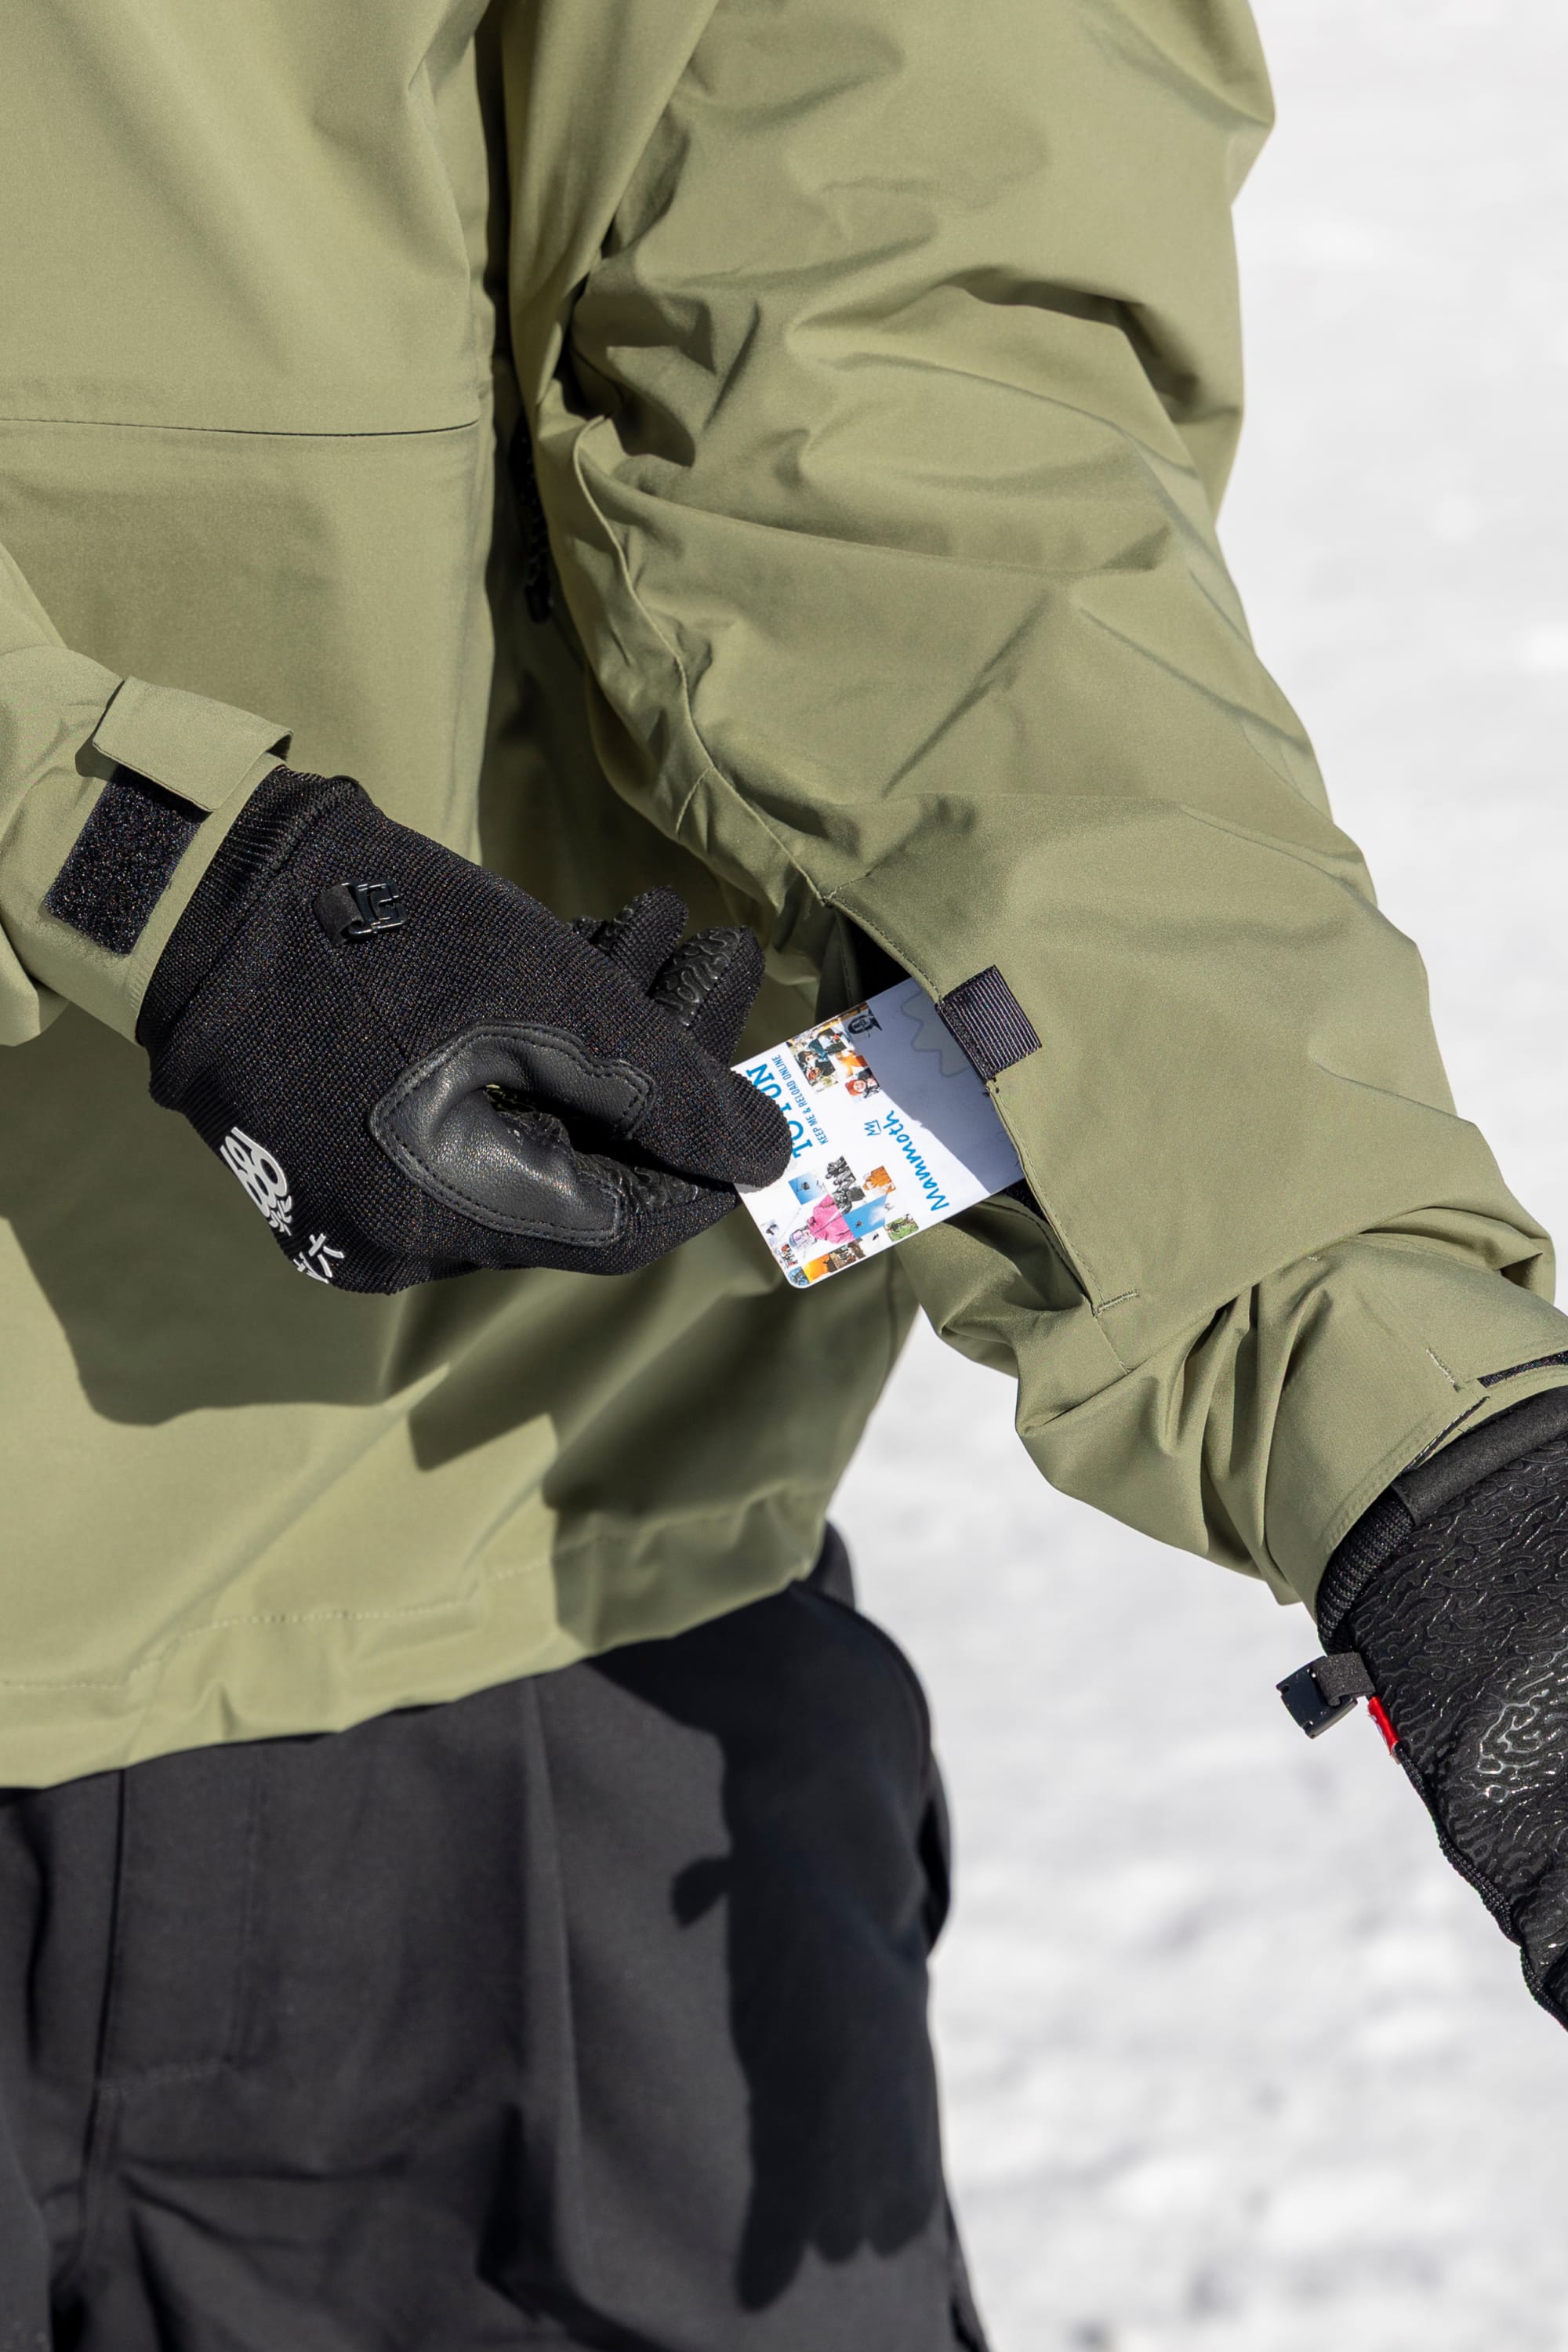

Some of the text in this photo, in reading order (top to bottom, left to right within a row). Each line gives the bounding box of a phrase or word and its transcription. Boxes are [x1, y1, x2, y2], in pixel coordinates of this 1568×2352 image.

[771, 1054, 792, 1080] ONLINE
[786, 1080, 808, 1108] RELOAD
[805, 1114, 818, 1127] ME
[813, 1127, 829, 1145] KEEP
[883, 1110, 949, 1211] Mammoth
